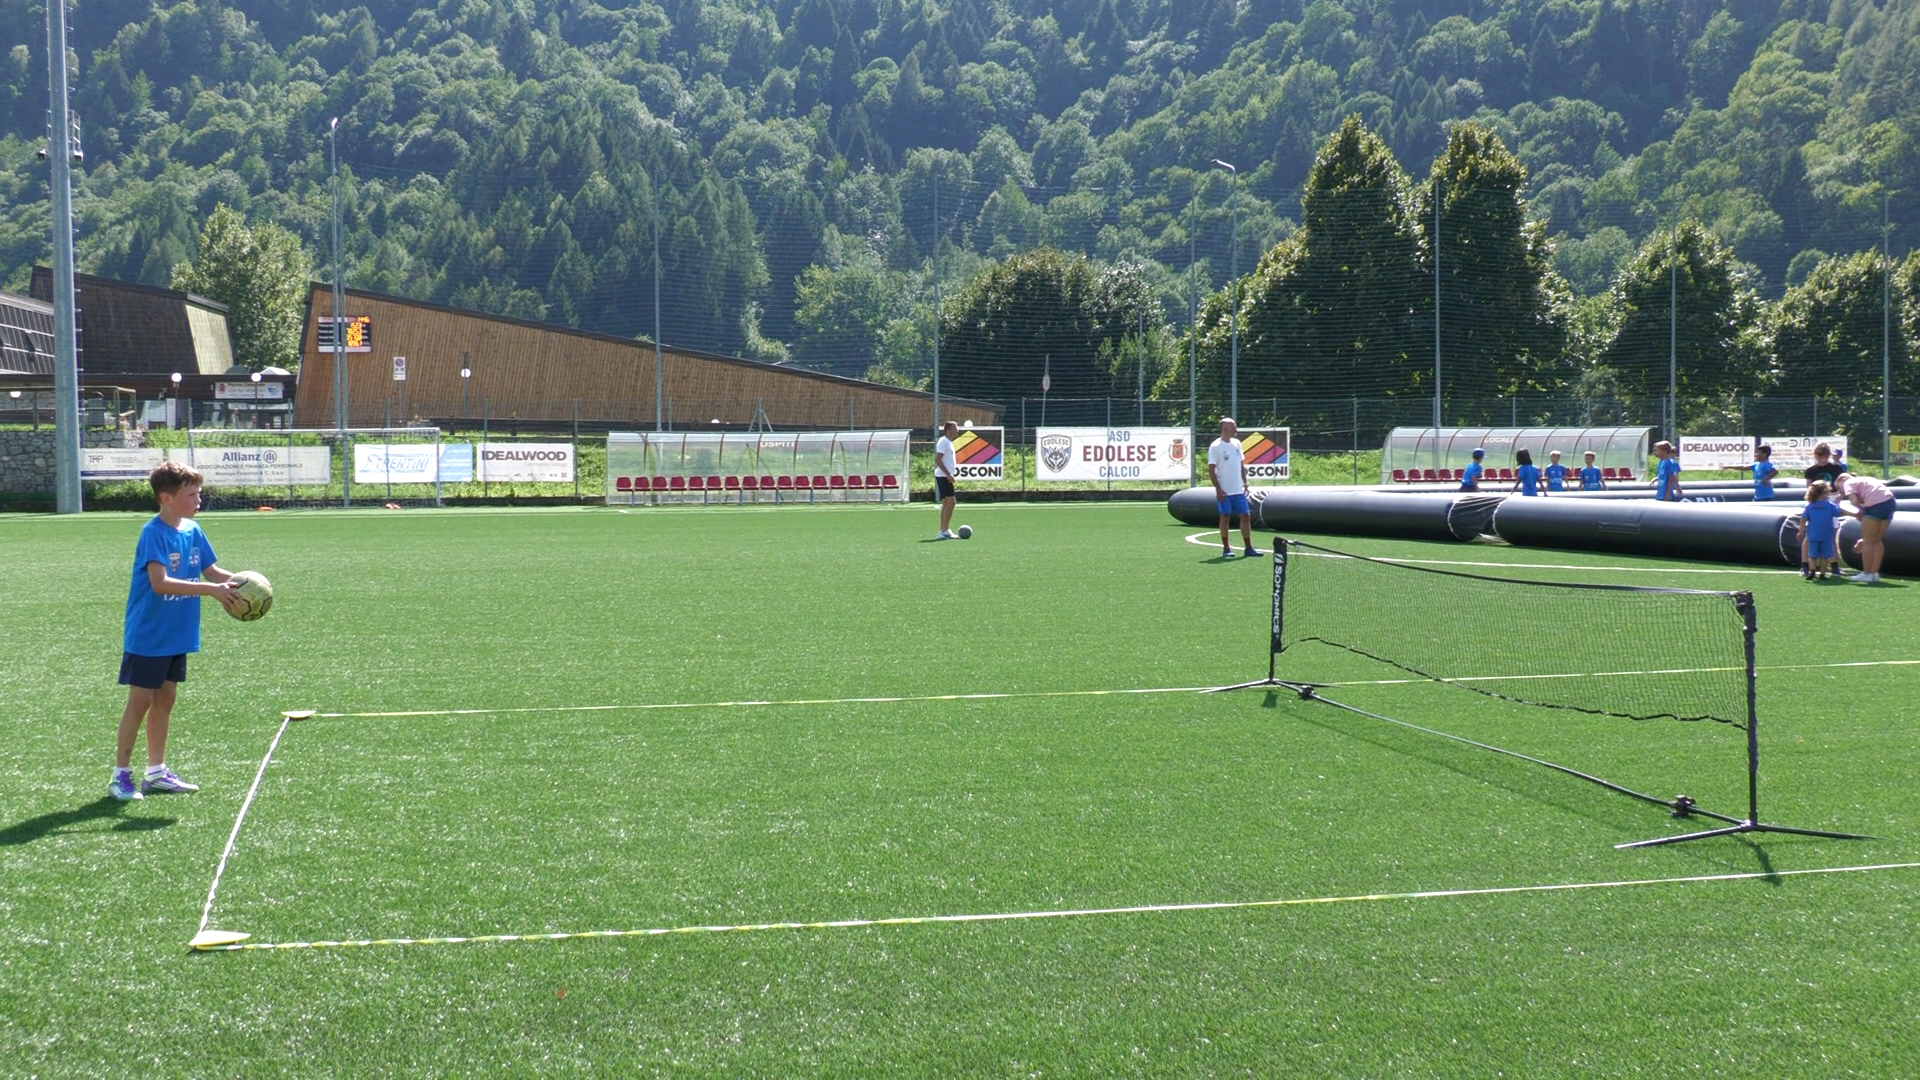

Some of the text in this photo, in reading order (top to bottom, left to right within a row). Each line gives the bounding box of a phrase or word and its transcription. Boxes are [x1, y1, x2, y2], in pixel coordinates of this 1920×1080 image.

[1044, 438, 1069, 446] EDOLESE
[1109, 431, 1130, 442] ASD
[1683, 443, 1750, 452] IDEALWOOD
[222, 451, 260, 461] Allianz
[481, 450, 567, 461] IDEALWOOD
[1083, 445, 1157, 462] EDOLESE
[1100, 465, 1140, 478] CALCIO
[1245, 466, 1288, 477] SCONI
